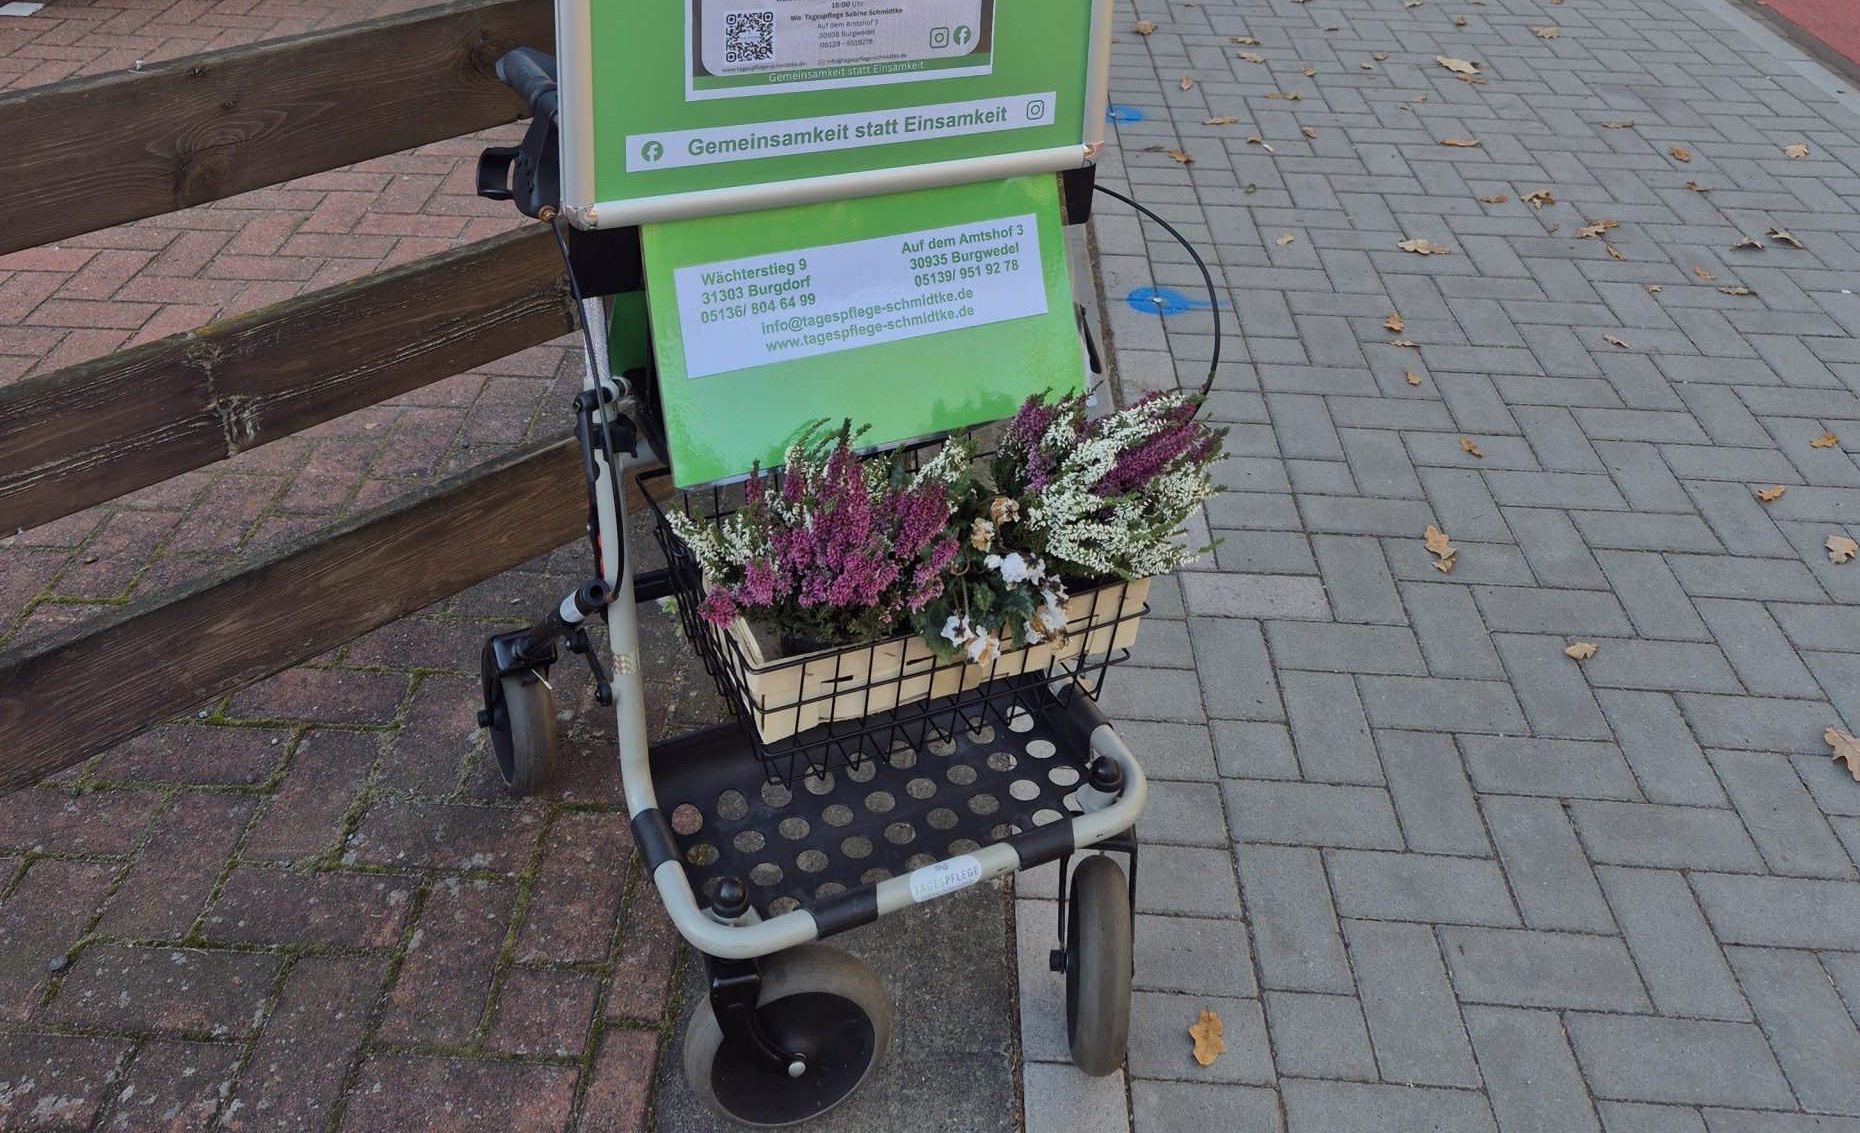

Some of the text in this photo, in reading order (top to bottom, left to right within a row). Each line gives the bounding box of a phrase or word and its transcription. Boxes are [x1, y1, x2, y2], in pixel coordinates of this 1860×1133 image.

[804, 11, 845, 22] Tagespflege
[845, 10, 868, 18] Sabine
[868, 7, 903, 17] Schmidtke
[851, 0, 865, 8] Uhr
[817, 22, 829, 30] Auf
[829, 21, 845, 29] dem
[846, 18, 874, 27] Amtshof
[841, 28, 876, 38] Burgwedel
[819, 40, 841, 49] 05139
[768, 61, 924, 83] Gemeinsamkeit statt Einsamkeit
[688, 105, 1008, 157] Gemeinsamkeit statt Einsamkeit
[901, 224, 1025, 255] Auf dem Amtshof 3
[909, 242, 1020, 270] 30935 Burgwedel
[701, 258, 808, 286] Wächterstieg 9
[914, 259, 1020, 287] 05139/ 951 92 78
[702, 275, 812, 305] 31303 Burgdorf
[700, 292, 817, 325] 05136/ 804 64 99
[761, 287, 975, 336] info@tagespflege-schmidtke.de
[765, 305, 976, 353] www.tagespflege-schmidtke.de
[912, 866, 980, 895] TAGESPFLEGE
